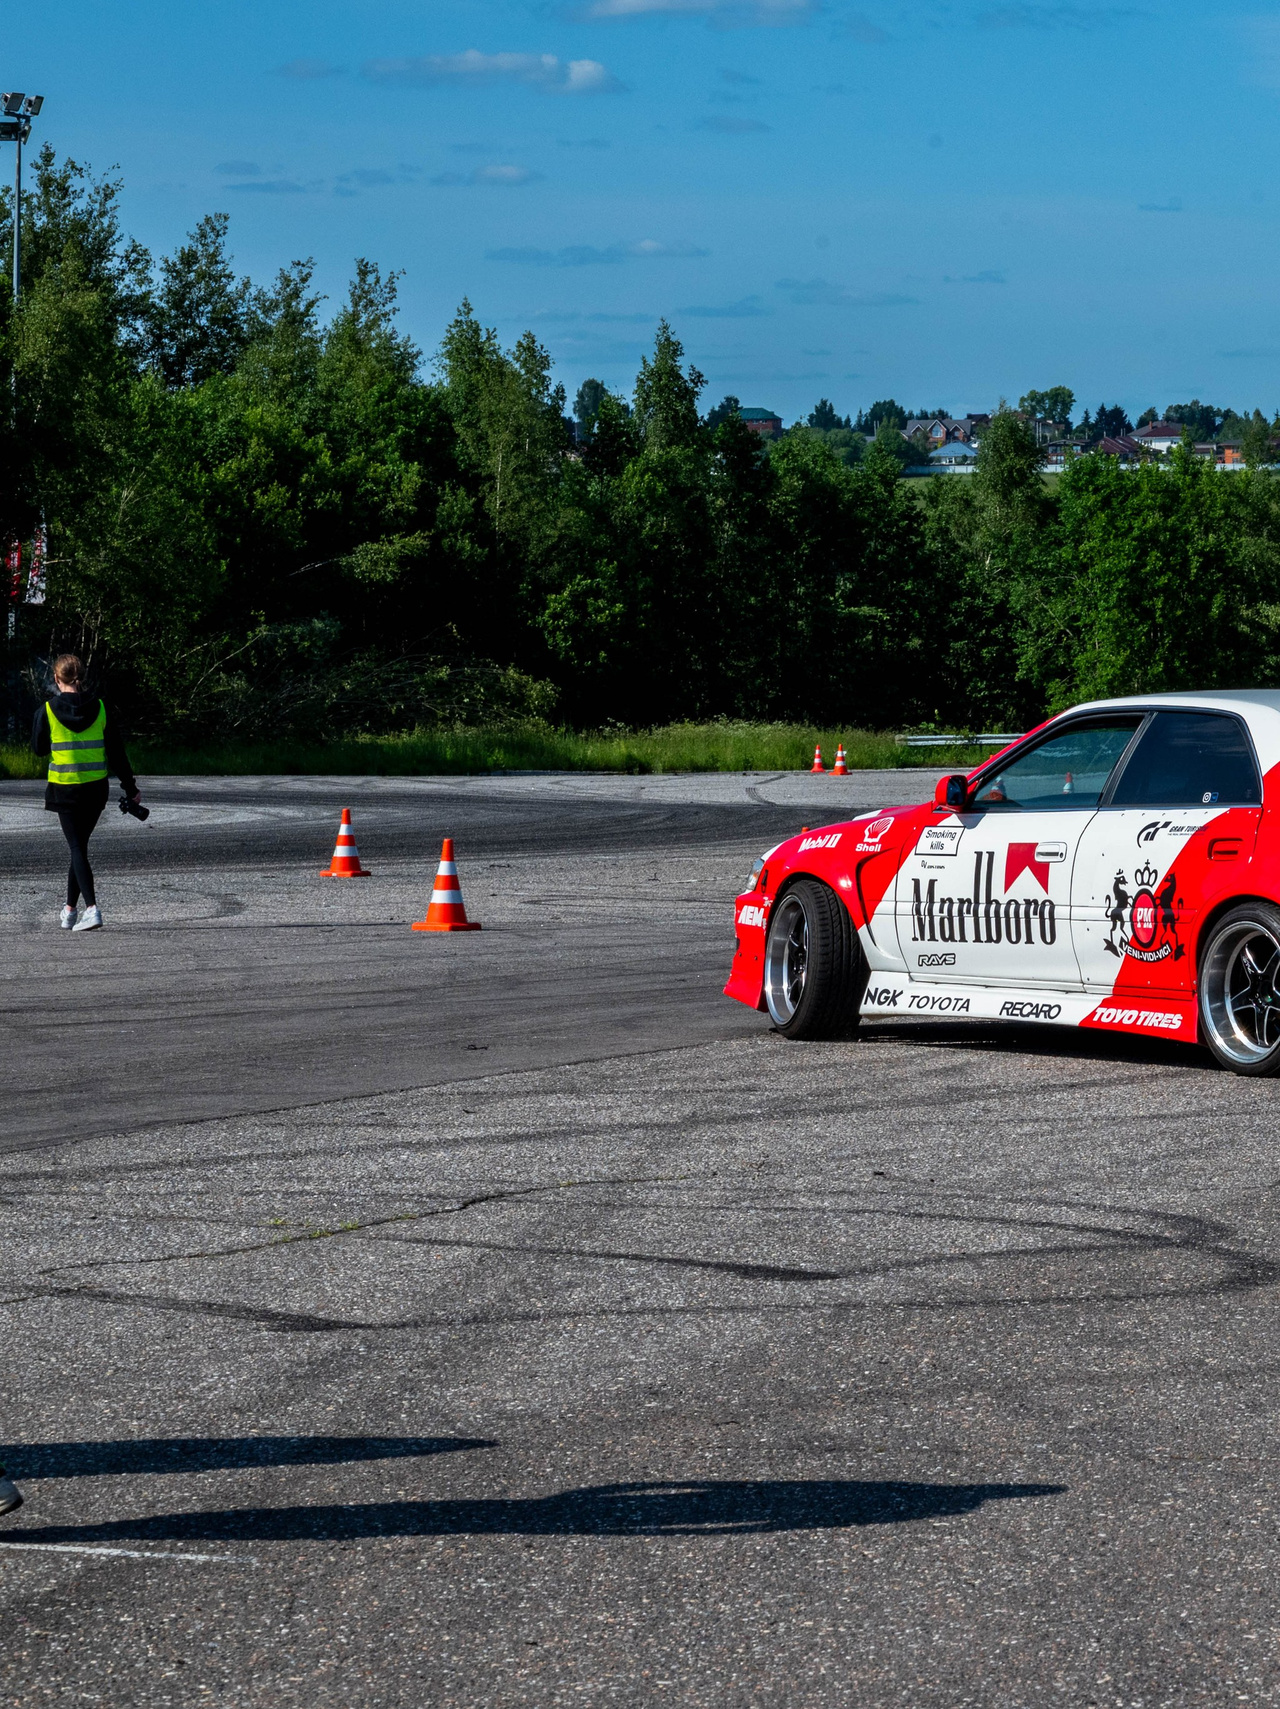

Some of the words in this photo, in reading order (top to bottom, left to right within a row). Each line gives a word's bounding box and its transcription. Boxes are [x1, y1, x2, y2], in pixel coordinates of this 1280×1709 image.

[797, 834, 831, 853] Mobil
[926, 829, 957, 841] Smoking
[930, 841, 945, 850] kills
[855, 843, 882, 852] Shell
[911, 851, 1056, 945] Marlboro
[737, 905, 765, 927] AEM
[1137, 907, 1153, 928] PM
[918, 953, 956, 967] RAYS
[1121, 941, 1172, 962] VENI-VIDI-VICI
[863, 987, 903, 1007] NGK
[908, 995, 971, 1012] TOYOTA
[999, 1001, 1061, 1020] RECARO
[1092, 1007, 1139, 1025] TOYO
[1136, 1010, 1183, 1029] TIRES
